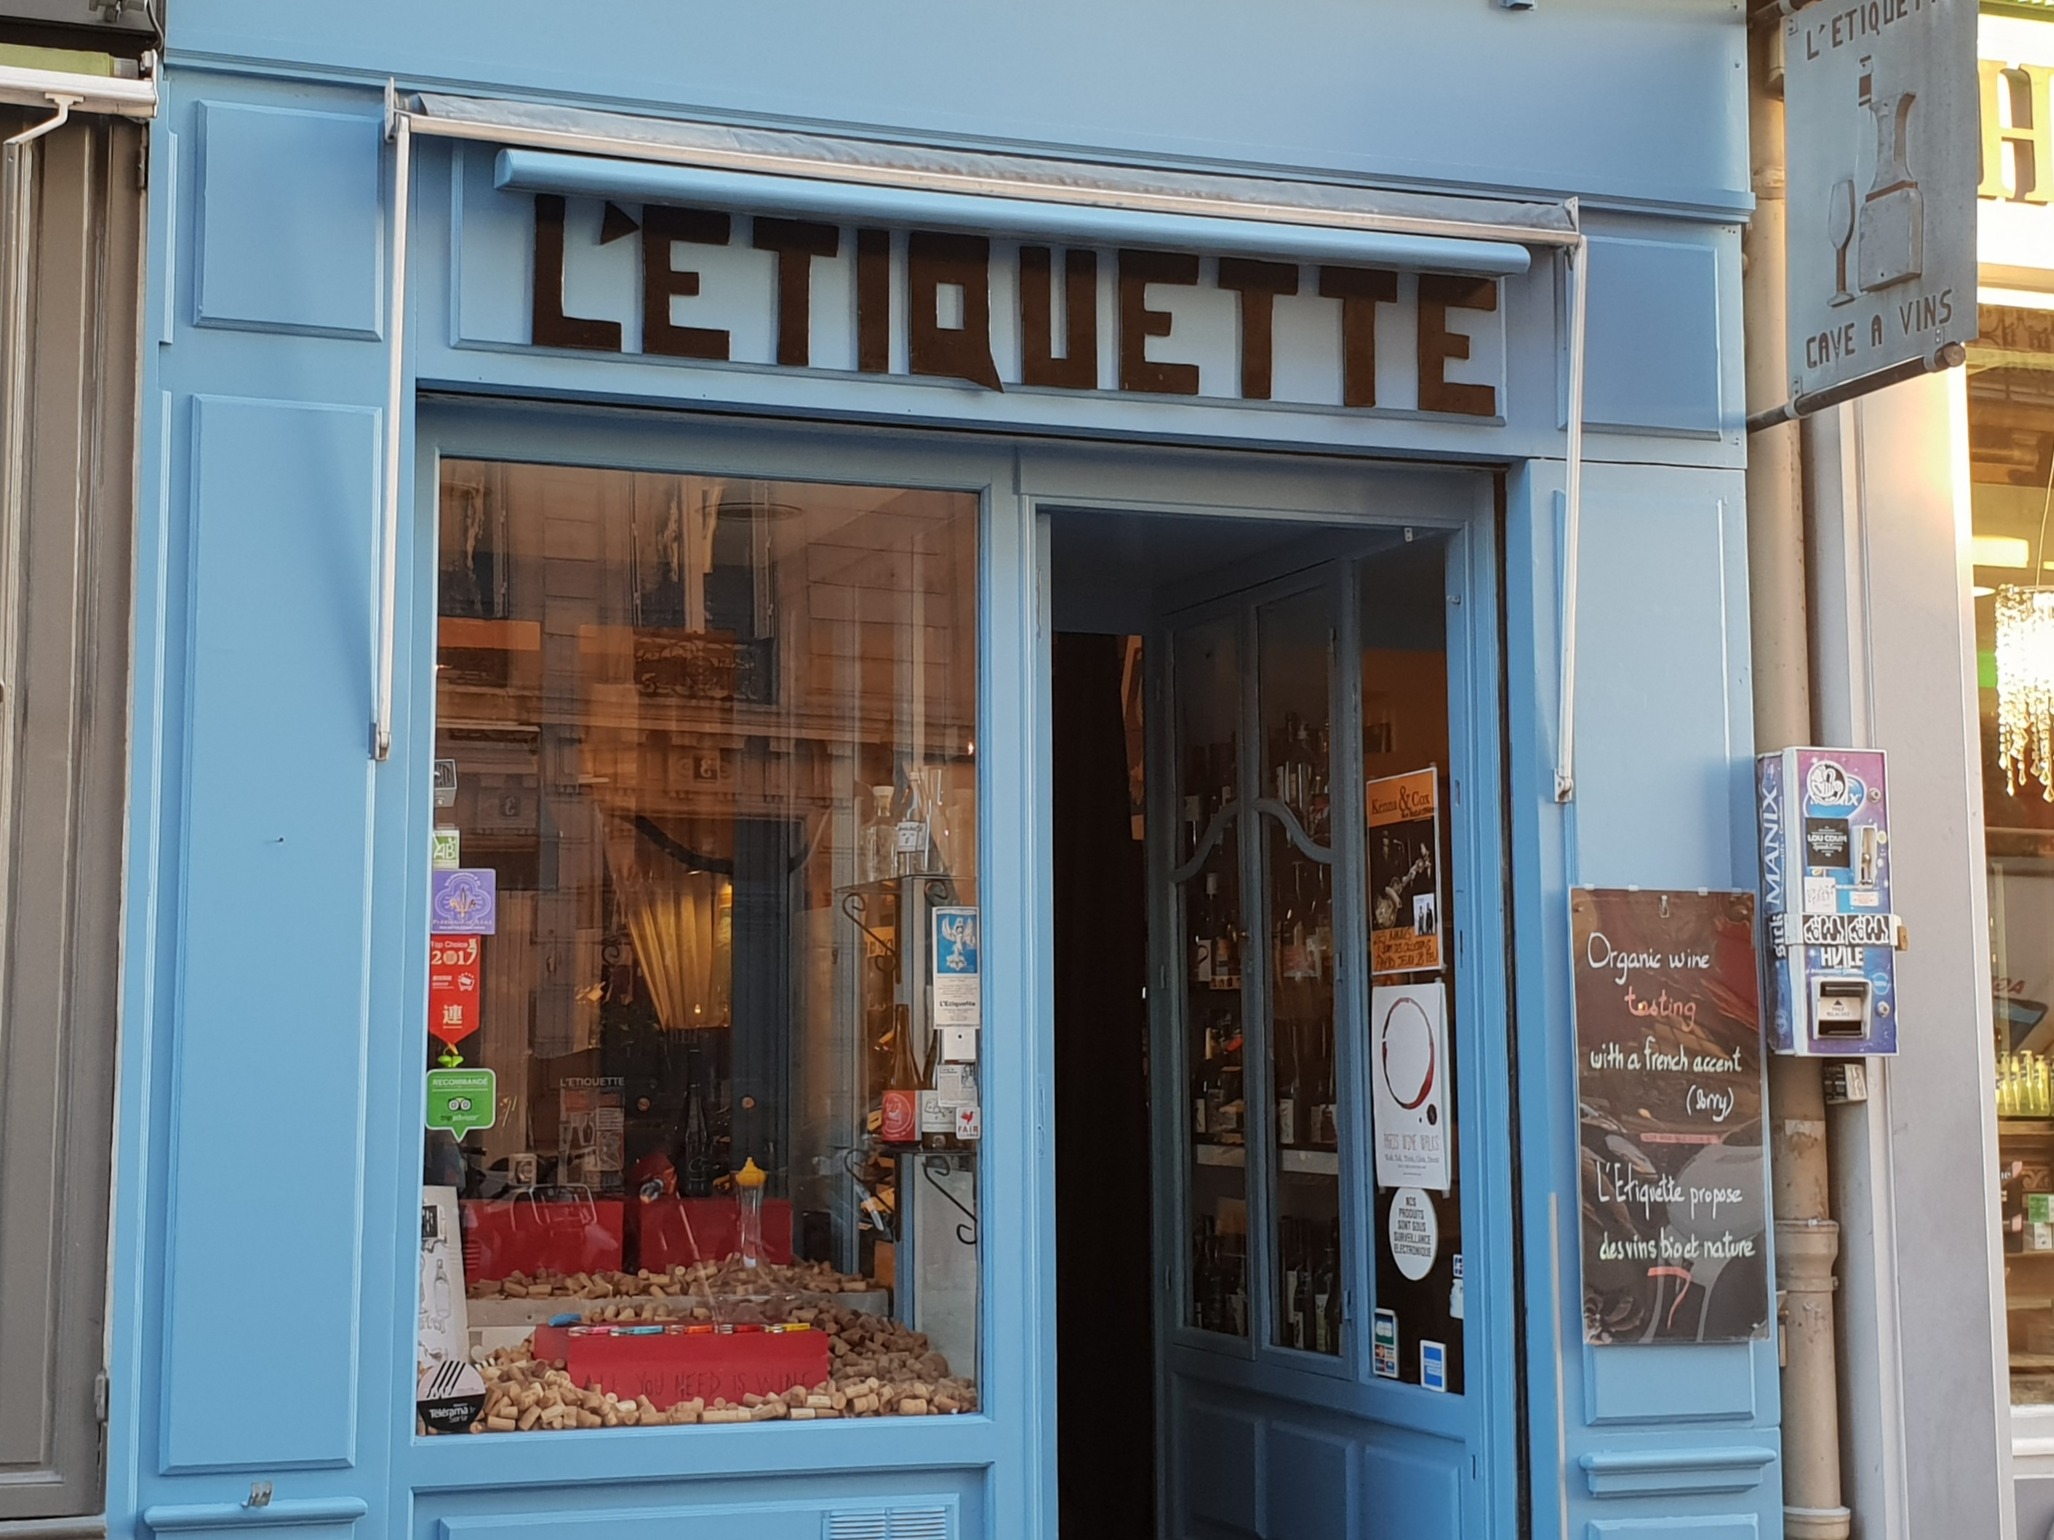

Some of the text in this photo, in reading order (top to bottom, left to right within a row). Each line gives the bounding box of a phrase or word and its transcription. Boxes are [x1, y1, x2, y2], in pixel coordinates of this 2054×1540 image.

[1805, 288, 1953, 369] CAVE A VINS
[1762, 786, 1781, 904] MANIX
[431, 938, 478, 966] 2017
[1587, 932, 1711, 985] Organic wine
[1590, 1036, 1743, 1073] with a french accent
[957, 1125, 979, 1134] FAIR
[1690, 1187, 1744, 1220] propose
[1599, 1231, 1625, 1260] des
[1625, 1235, 1657, 1260] vins
[1659, 1226, 1682, 1259] bio
[1703, 1230, 1757, 1259] nature
[674, 1372, 721, 1397] NEED
